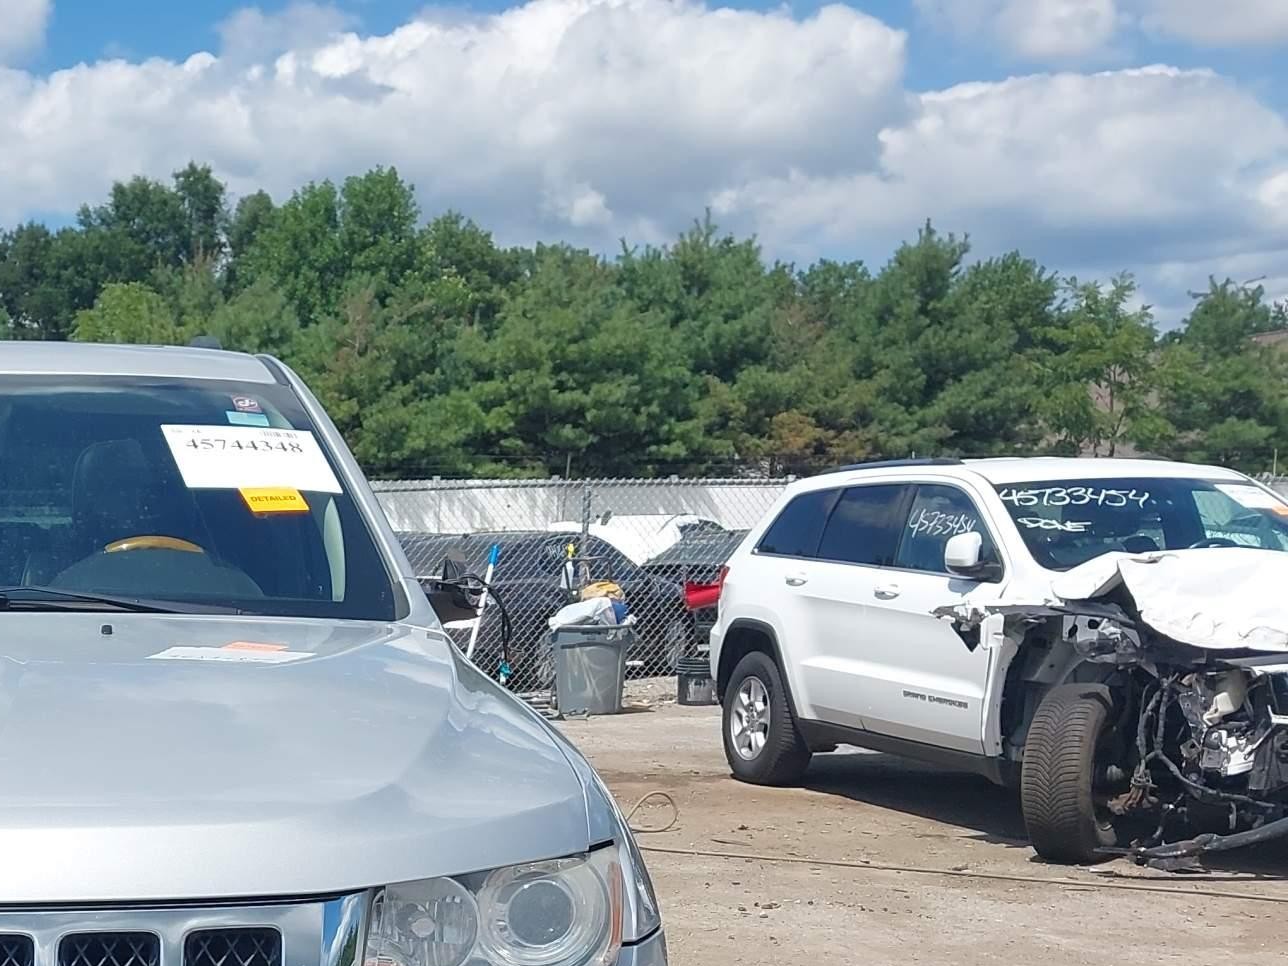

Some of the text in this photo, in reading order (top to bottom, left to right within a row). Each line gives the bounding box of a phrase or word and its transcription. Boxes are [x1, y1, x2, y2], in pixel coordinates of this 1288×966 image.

[186, 438, 303, 454] 45744348
[250, 495, 297, 503] DETAILED
[999, 487, 1149, 509] 45733454
[1017, 518, 1092, 532] DONE
